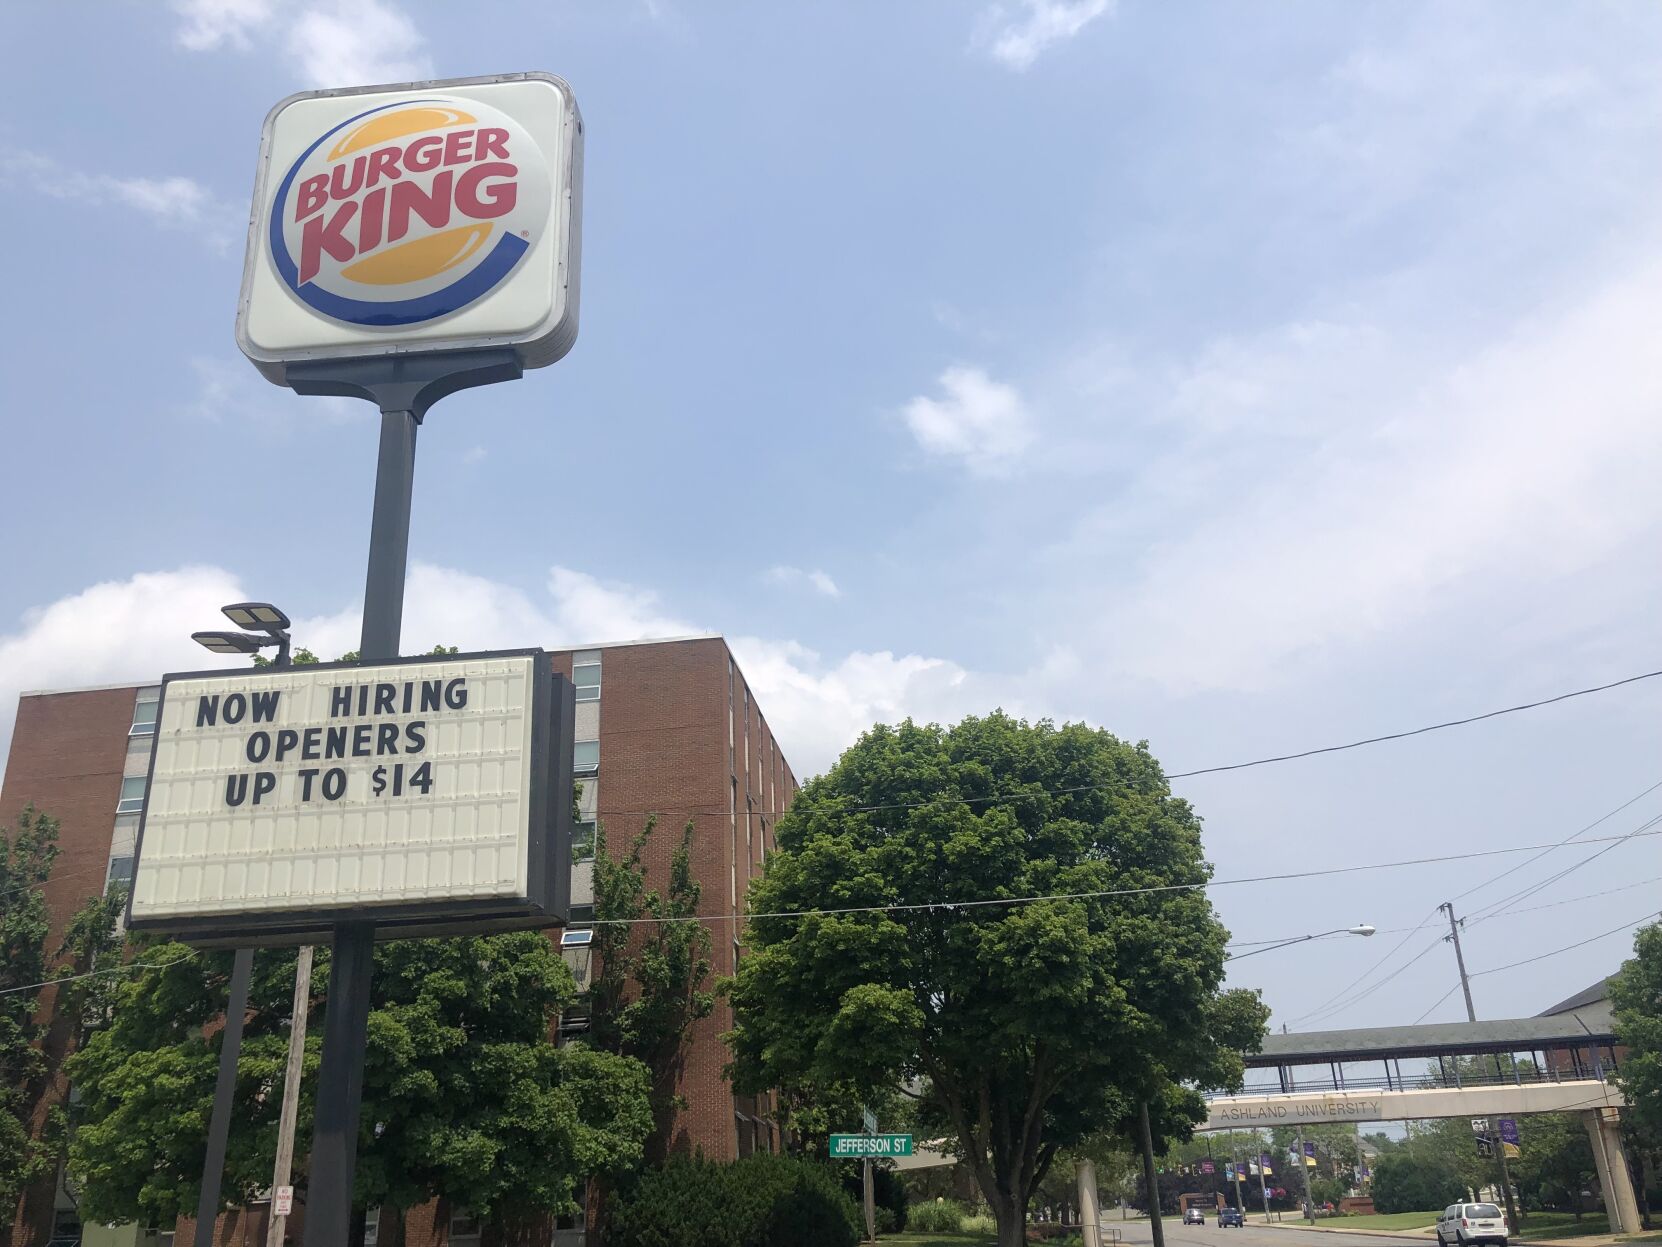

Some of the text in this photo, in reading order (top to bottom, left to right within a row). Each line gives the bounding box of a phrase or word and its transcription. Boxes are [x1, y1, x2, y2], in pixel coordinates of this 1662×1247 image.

[295, 128, 510, 222] BURGER
[299, 162, 518, 284] KING
[197, 678, 468, 727] NOW HIRING
[246, 721, 426, 763] OPENERS
[226, 761, 433, 807] UP TO $14
[1220, 1101, 1379, 1121] ASHLAND UNIVERSITY
[835, 1138, 907, 1153] JEFFERSON ST
